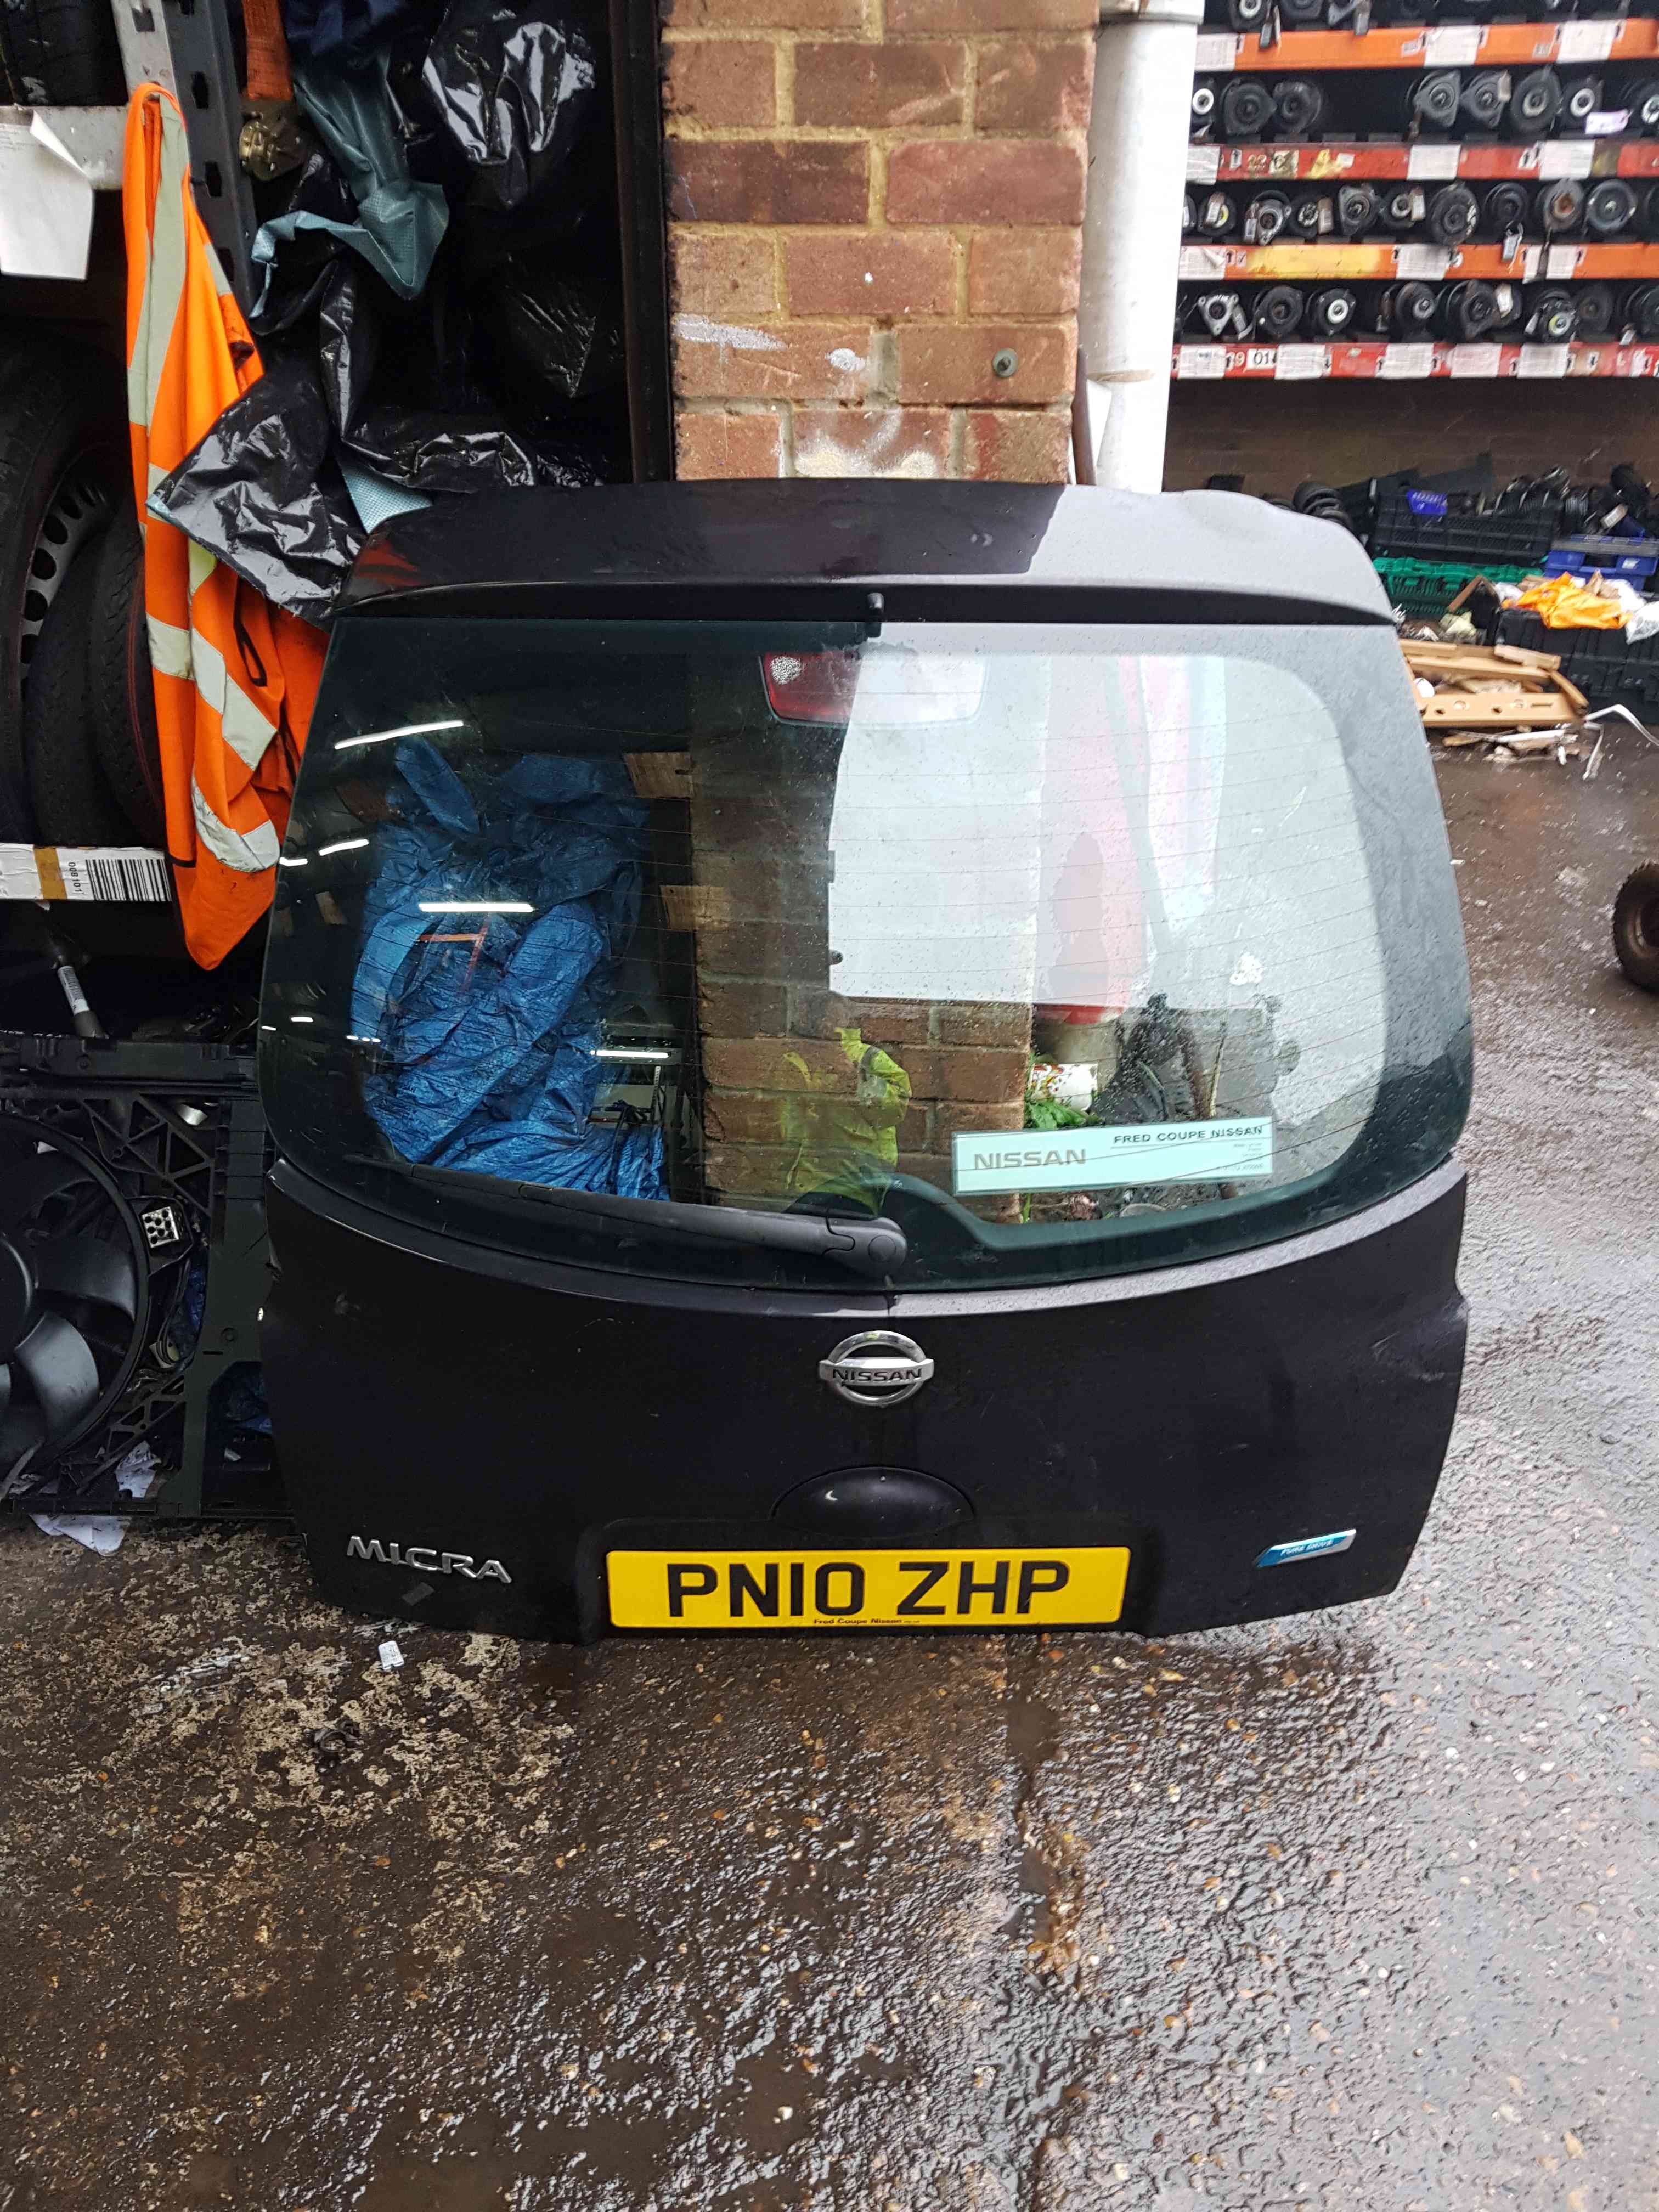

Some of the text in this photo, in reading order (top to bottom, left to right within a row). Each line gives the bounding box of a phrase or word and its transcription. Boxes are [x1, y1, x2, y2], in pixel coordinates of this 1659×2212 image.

[68, 862, 83, 892] 008101
[1114, 1125, 1263, 1144] FRED COUPE NISSAN
[974, 1148, 1086, 1170] NISSAN
[832, 1368, 923, 1382] NISSAN
[346, 1535, 512, 1584] MICRA
[666, 1560, 1070, 1617] PN10 ZHP
